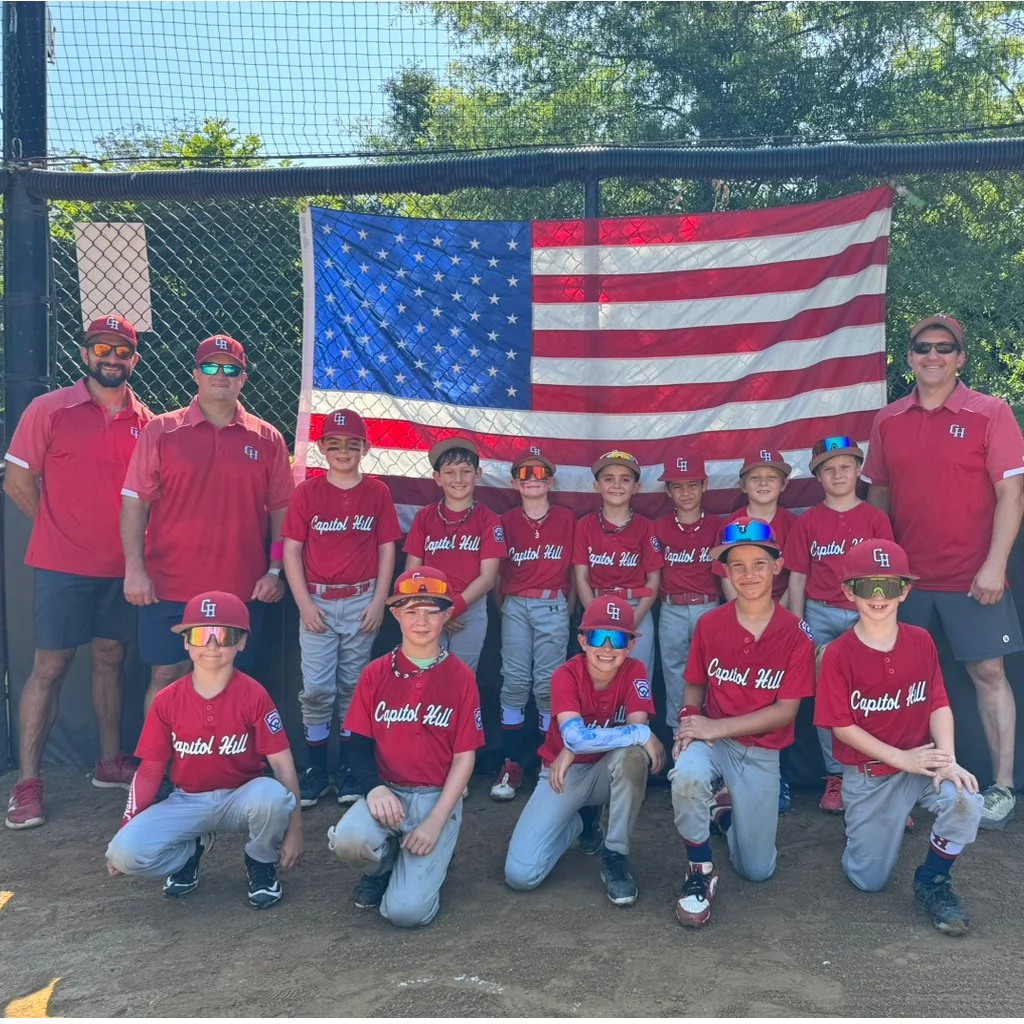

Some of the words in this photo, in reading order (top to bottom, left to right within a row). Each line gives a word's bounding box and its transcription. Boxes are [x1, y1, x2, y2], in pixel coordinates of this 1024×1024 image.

[311, 515, 347, 535] Capitol
[352, 515, 374, 531] Hill
[459, 535, 481, 552] Hill
[508, 545, 541, 567] Capitol
[544, 545, 564, 560] Hill
[619, 551, 639, 567] Hill
[873, 548, 890, 568] CH
[201, 599, 216, 617] CH
[606, 602, 620, 621] CH
[707, 658, 750, 687] Capitol
[755, 668, 784, 690] Hill
[851, 689, 901, 717] Capitol
[906, 681, 926, 707] Hill
[375, 701, 422, 728] Capitol
[422, 704, 454, 728] Hill
[218, 733, 249, 756] Hill
